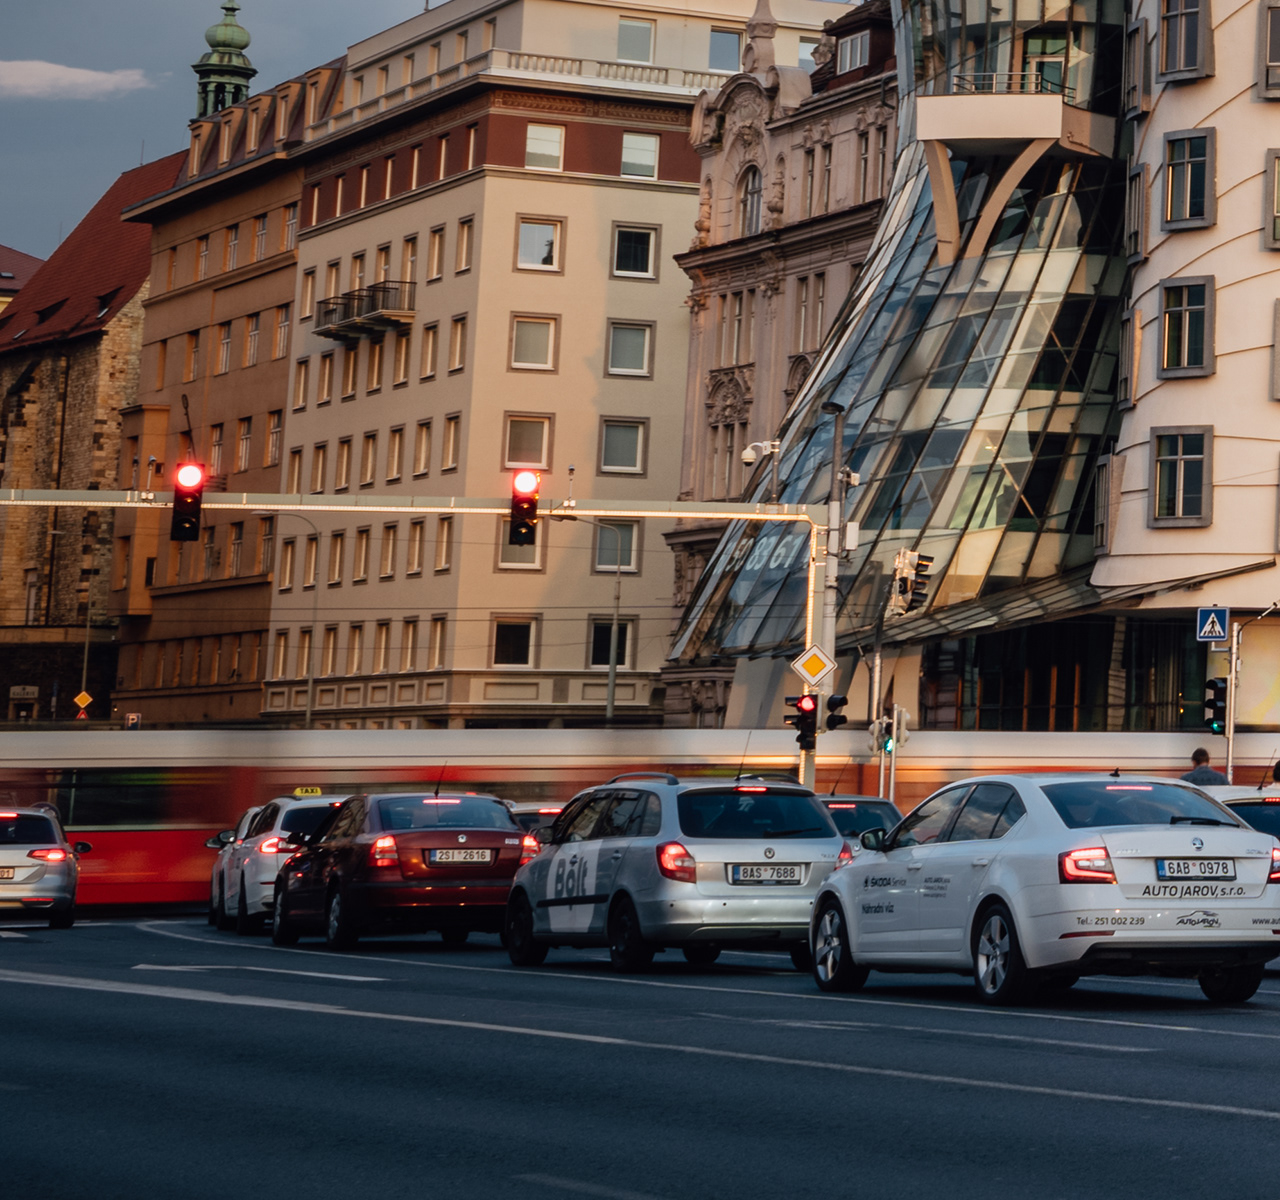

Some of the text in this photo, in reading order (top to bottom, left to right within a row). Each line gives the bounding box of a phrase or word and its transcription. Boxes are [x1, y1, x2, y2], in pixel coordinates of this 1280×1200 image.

[128, 715, 137, 727] P
[463, 851, 486, 860] 2616
[742, 867, 796, 878] 8AS 7688
[1168, 862, 1229, 874] 6AB 0978
[554, 856, 588, 898] Bolt
[1142, 885, 1178, 896] AUTO
[1094, 917, 1109, 925] 251
[1111, 917, 1127, 925] 002
[1129, 917, 1145, 925] 239
